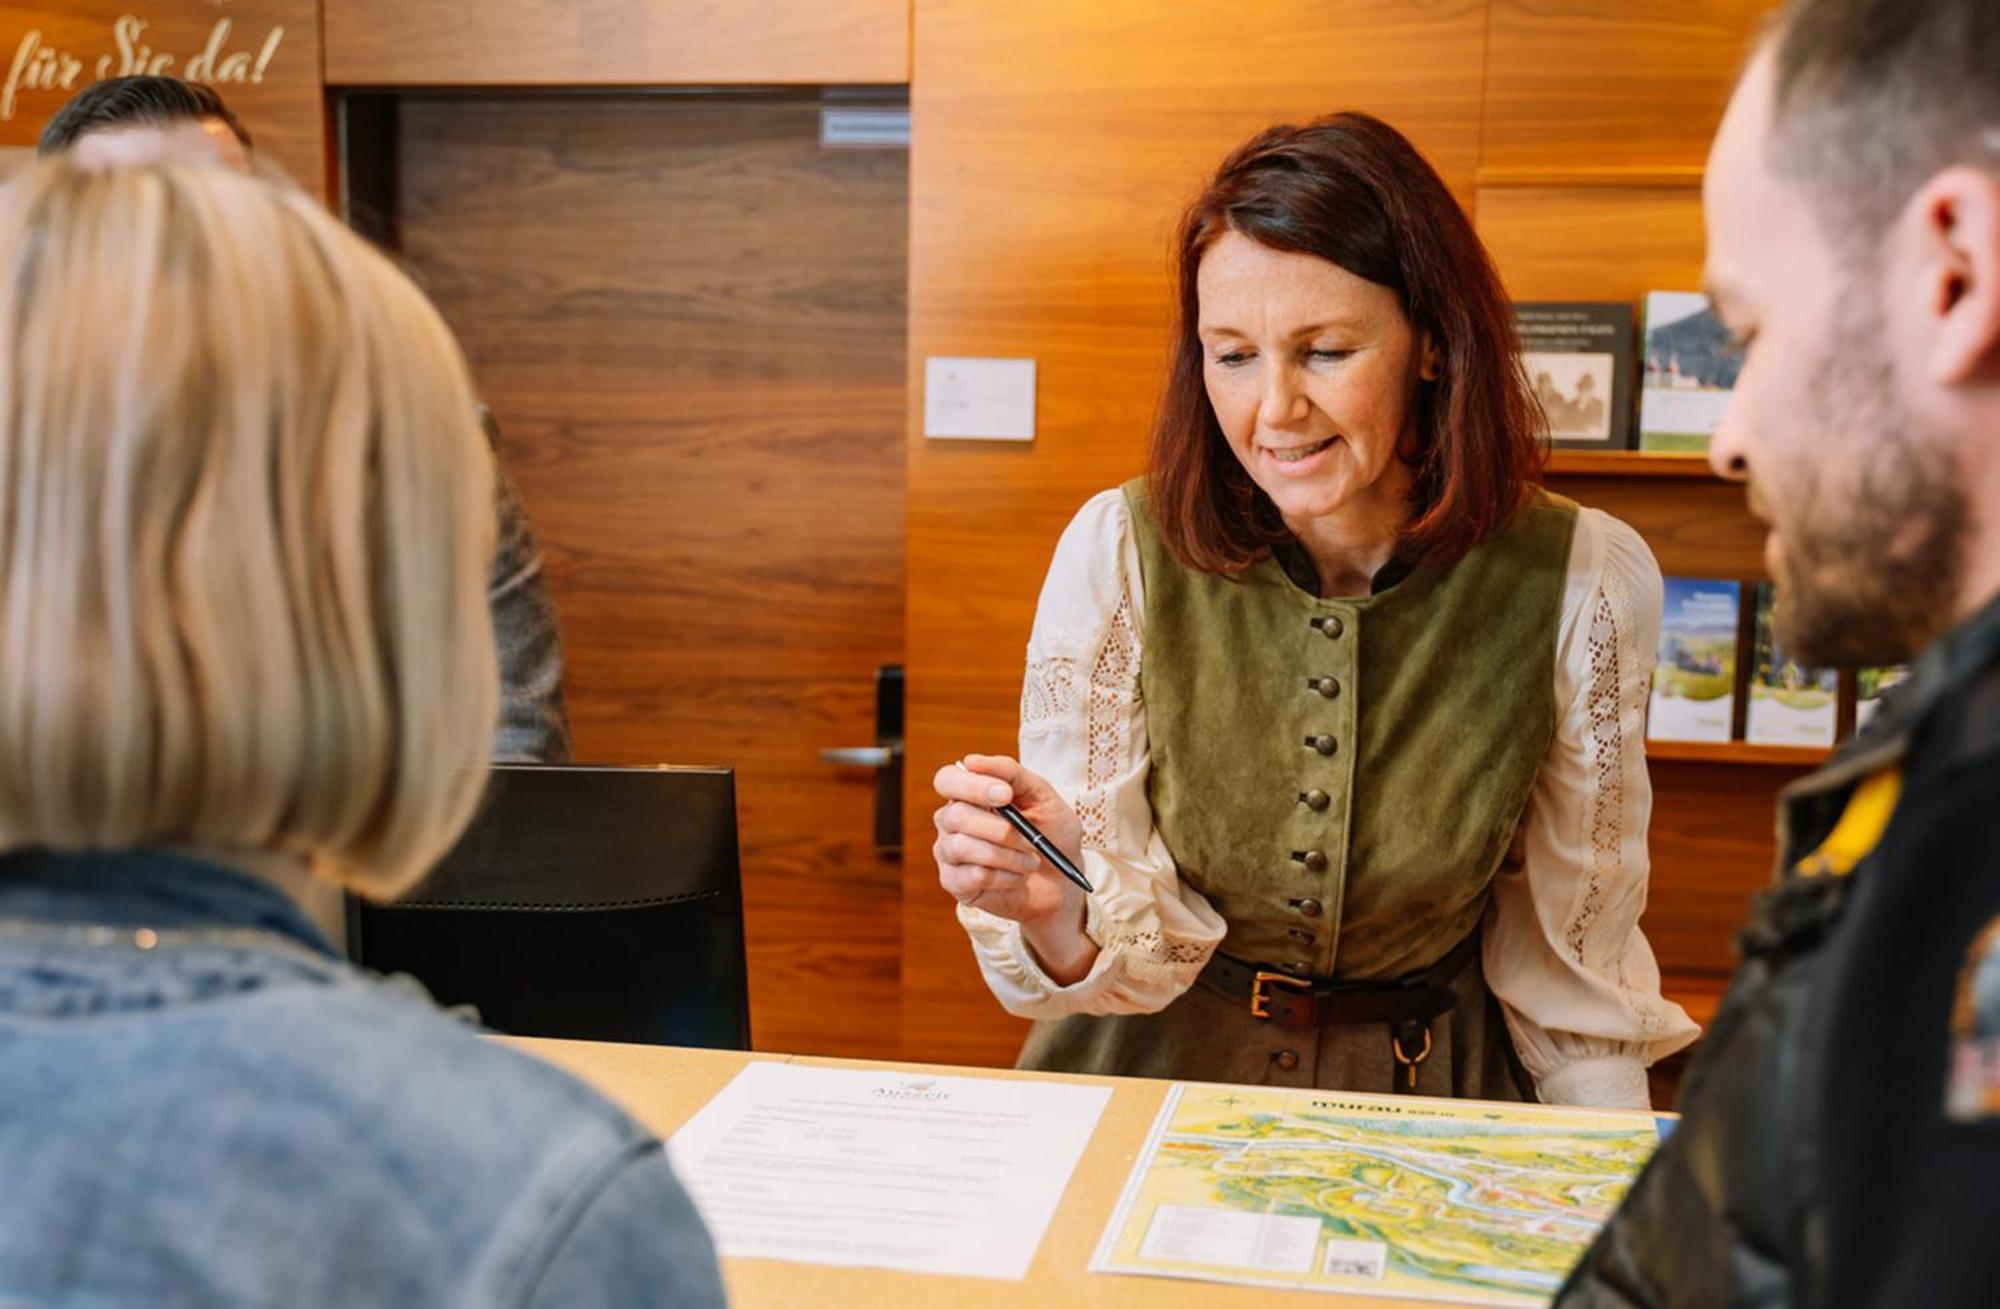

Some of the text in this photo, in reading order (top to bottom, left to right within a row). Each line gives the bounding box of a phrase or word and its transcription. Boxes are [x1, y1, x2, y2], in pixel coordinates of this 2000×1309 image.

[2, 14, 285, 121] für Sie da!
[1311, 1100, 1402, 1114] murau
